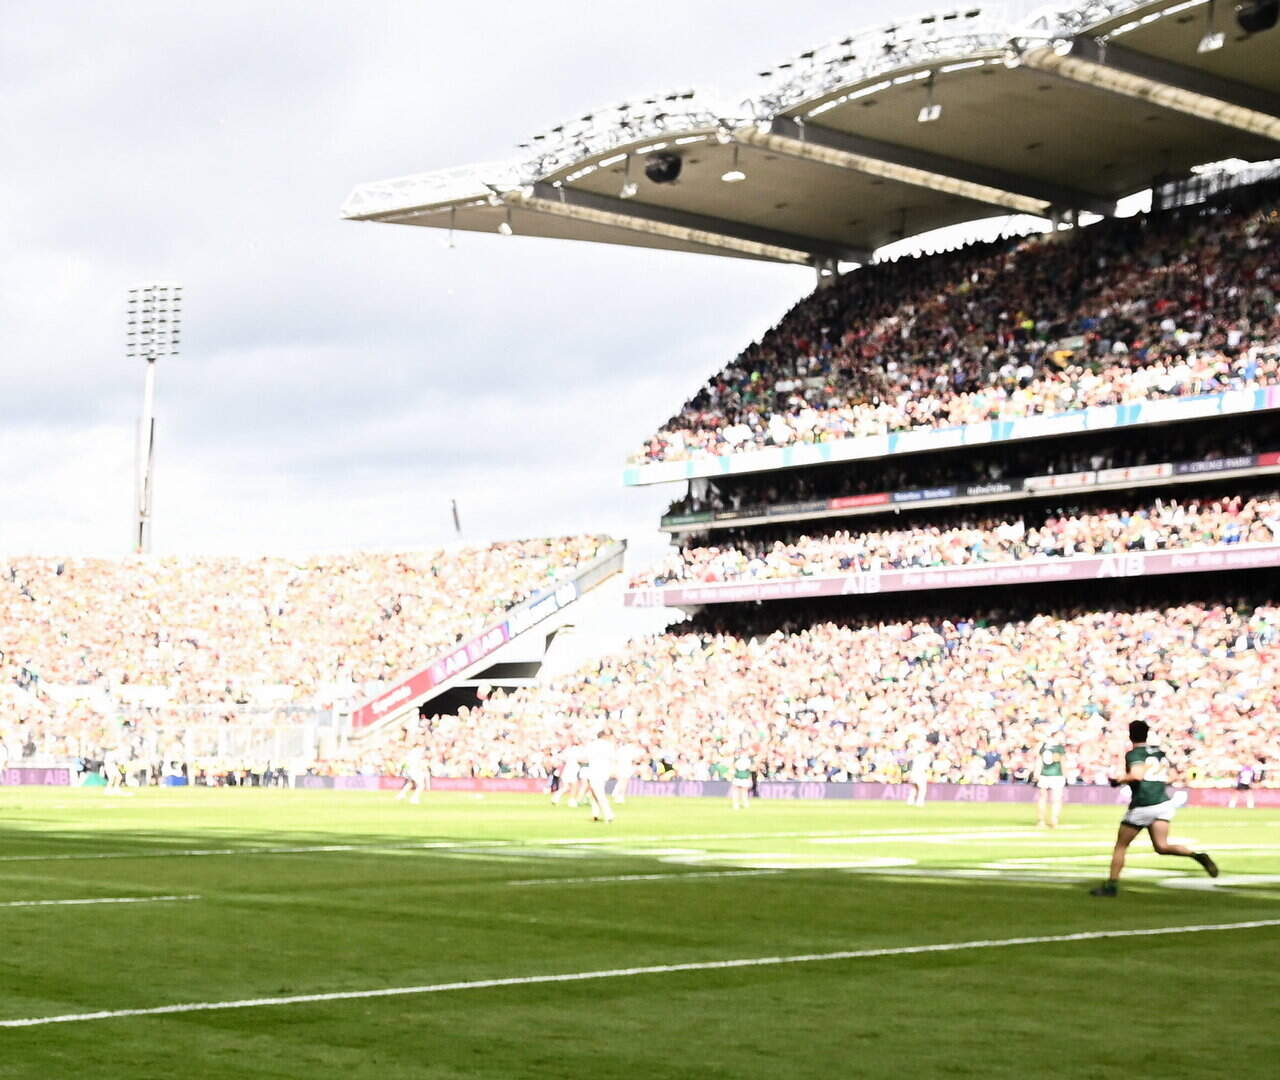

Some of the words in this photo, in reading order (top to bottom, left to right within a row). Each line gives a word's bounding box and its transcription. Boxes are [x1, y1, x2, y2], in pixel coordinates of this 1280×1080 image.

[1097, 556, 1145, 578] AIB
[842, 573, 881, 595] AIB
[44, 769, 70, 785] AIB
